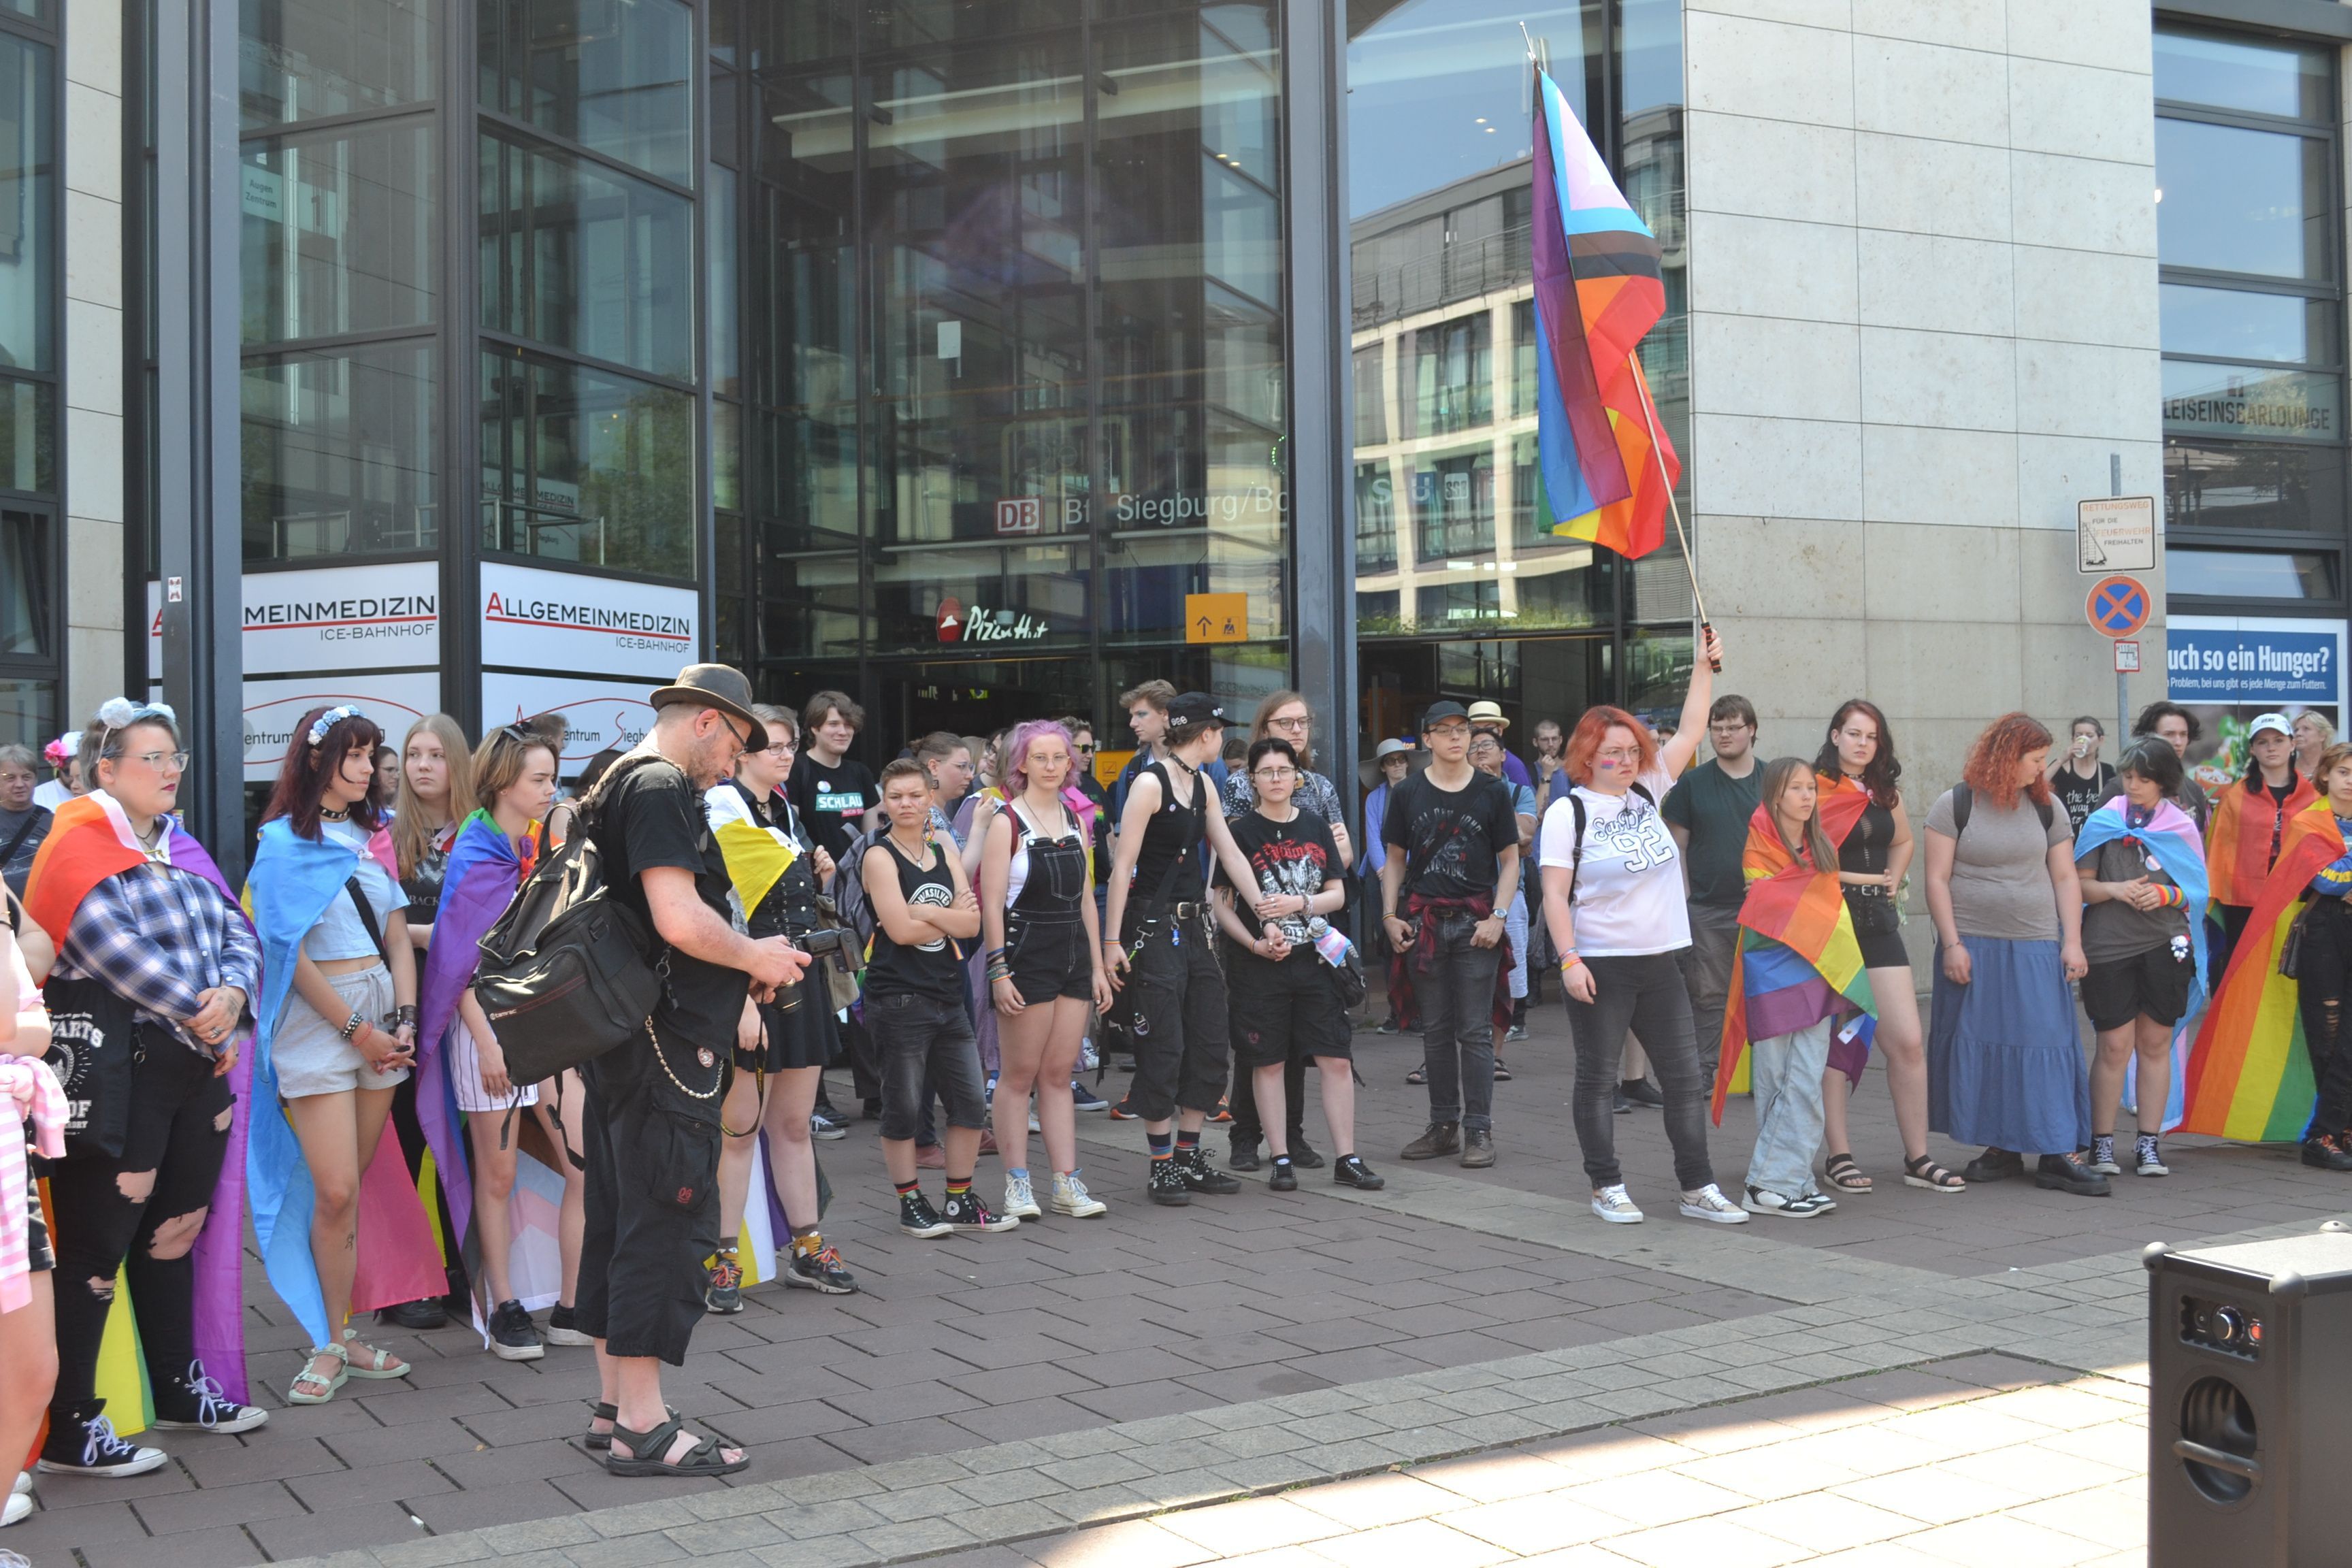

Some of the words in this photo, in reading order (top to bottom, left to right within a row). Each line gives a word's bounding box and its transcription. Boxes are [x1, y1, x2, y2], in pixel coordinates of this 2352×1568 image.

[249, 179, 274, 194] Augen
[245, 191, 278, 209] Zentrum
[1117, 486, 1288, 525] Siegburg/Bo
[2082, 501, 2149, 512] RETTUNGSWEG
[1000, 502, 1038, 529] DB
[2092, 517, 2106, 525] FÜR
[2095, 527, 2152, 537] FEUERWEHR
[2104, 538, 2144, 546] FREIHALTEN
[485, 591, 691, 636] ALLGEMEINMEDIZIN
[320, 623, 436, 641] ICE-BAHNHOF
[615, 636, 691, 653] ICE-BAHNHOF
[2167, 643, 2200, 671] uch
[2202, 649, 2224, 671] so
[2227, 644, 2255, 672] ein
[2257, 645, 2330, 679] Hunger?
[2170, 676, 2201, 689] Problem,
[2201, 677, 2212, 689] bei
[2212, 680, 2225, 689] uns
[2225, 678, 2239, 691] gibt
[2240, 680, 2249, 689] es
[2249, 678, 2264, 691] jede
[2264, 679, 2286, 691] Menge
[2287, 681, 2301, 689] zum
[818, 795, 862, 809] SCHLAU
[2066, 789, 2082, 804] the
[2070, 804, 2089, 817] way
[2071, 816, 2082, 825] to
[1611, 818, 1674, 874] 92
